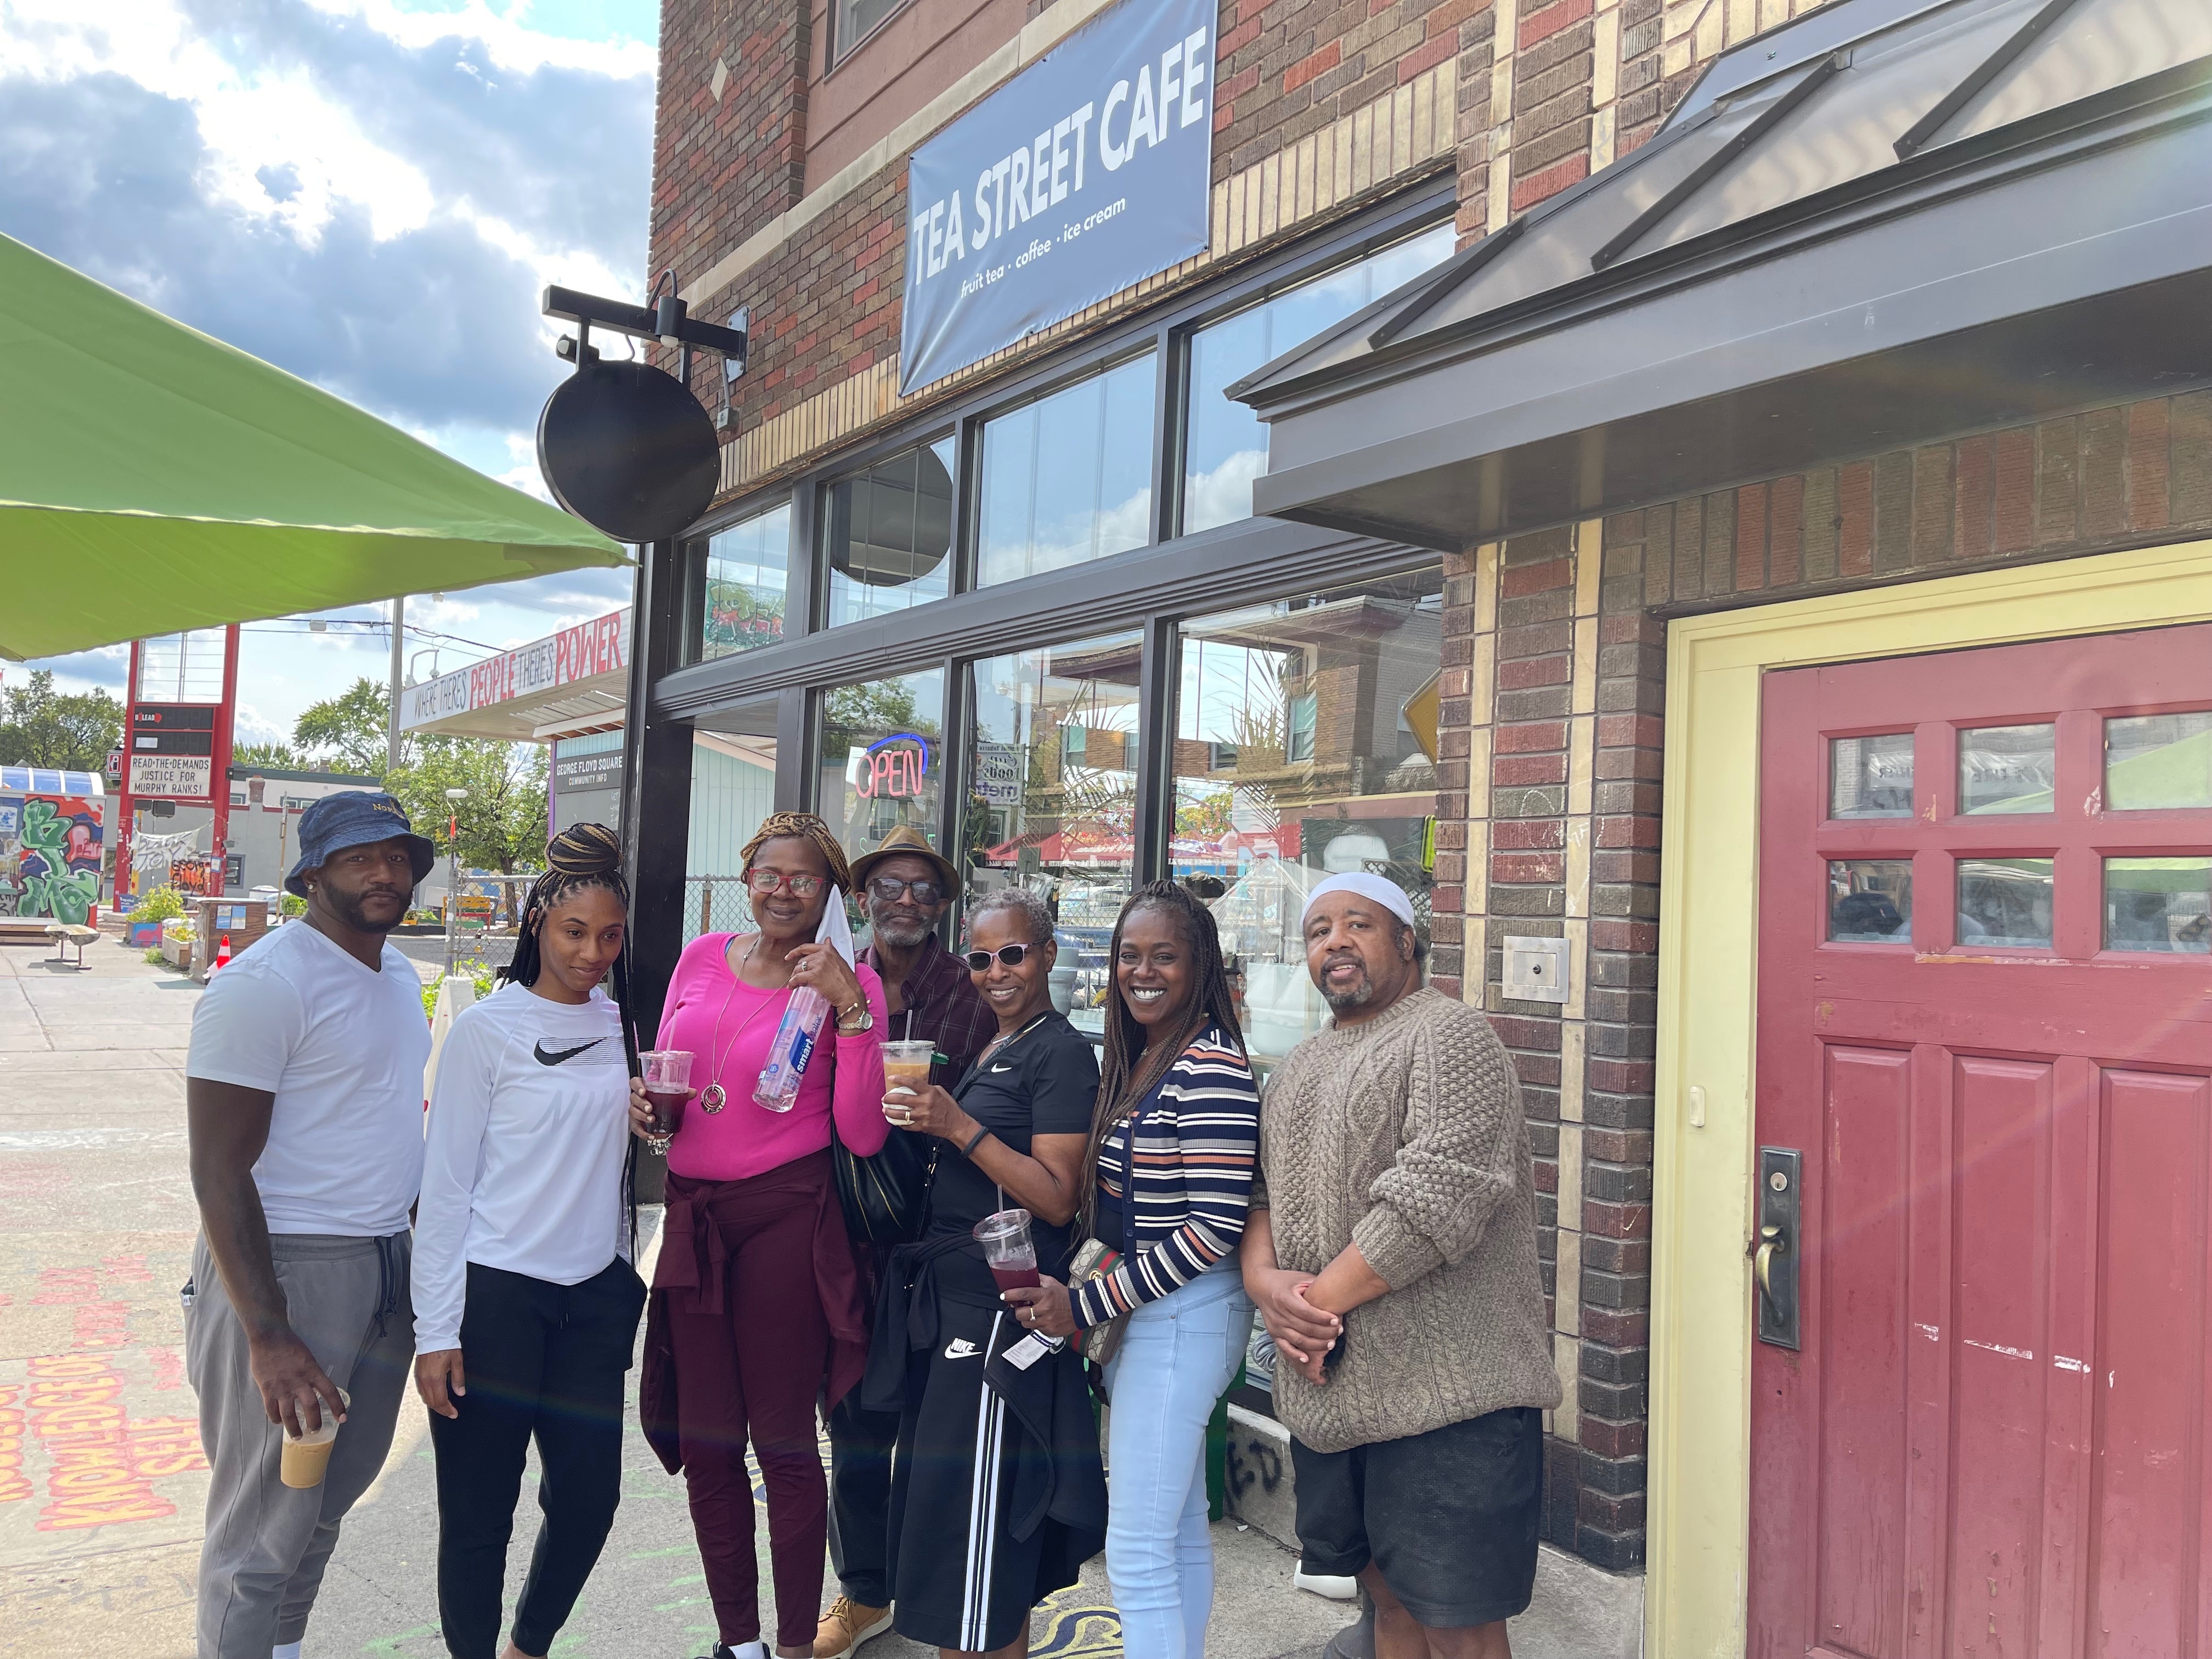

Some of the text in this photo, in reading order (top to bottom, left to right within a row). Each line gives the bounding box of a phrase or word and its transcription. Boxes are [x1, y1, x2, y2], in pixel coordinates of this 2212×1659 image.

[914, 25, 1206, 285] TEA STREET CAFE
[961, 197, 1126, 298] fruit tea coffee ice cream
[414, 612, 623, 719] WHERE THERE'S PEOPLE THERE'S POWER
[133, 758, 209, 769] READ THE DEMANDS
[140, 770, 195, 782] JUSTICE FOR
[557, 755, 623, 776] GEORGE FLOYD SQUARE
[855, 748, 924, 799] OPEN
[134, 783, 202, 794] MURPHY RANKS!
[569, 773, 607, 786] COMMUNITY INFO
[797, 1038, 814, 1073] smart
[529, 1088, 630, 1135] NIK
[951, 1338, 975, 1354] NIKE
